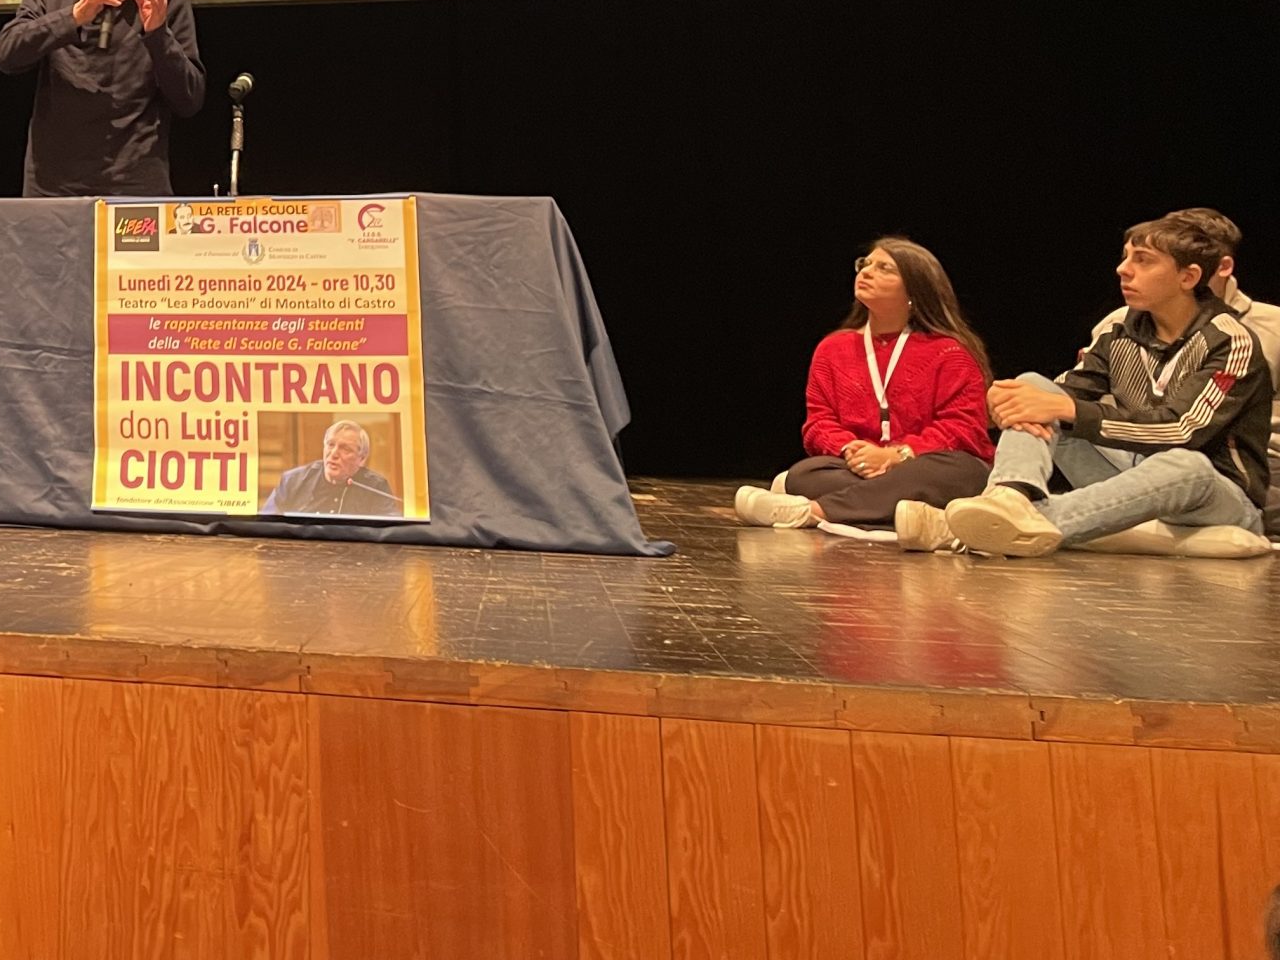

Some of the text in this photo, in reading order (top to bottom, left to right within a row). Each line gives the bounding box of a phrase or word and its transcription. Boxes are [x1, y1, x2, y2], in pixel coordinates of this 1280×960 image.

[199, 205, 308, 216] LA RETE DI SCUOLE
[200, 215, 309, 234] G. Falcone
[119, 274, 170, 291] Lunedì
[175, 275, 194, 291] 22
[198, 274, 262, 295] gennaio
[267, 274, 306, 291] 2024
[322, 278, 349, 291] ore
[353, 274, 395, 293] 10,30
[118, 297, 157, 309] Teatro
[161, 297, 188, 309] “Lea
[260, 297, 271, 309] di
[275, 297, 335, 309] Montalto
[339, 297, 351, 309] di
[354, 297, 396, 309] Castro
[149, 317, 365, 334] le rappresentanze degli studenti
[148, 336, 180, 349] della
[184, 337, 221, 350] “Rete
[224, 337, 237, 350] di
[240, 337, 284, 350] Scuole
[288, 338, 302, 351] G.
[121, 360, 400, 405] INCONTRANO
[120, 410, 249, 448] don Luigi
[119, 449, 247, 492] CIOTTI
